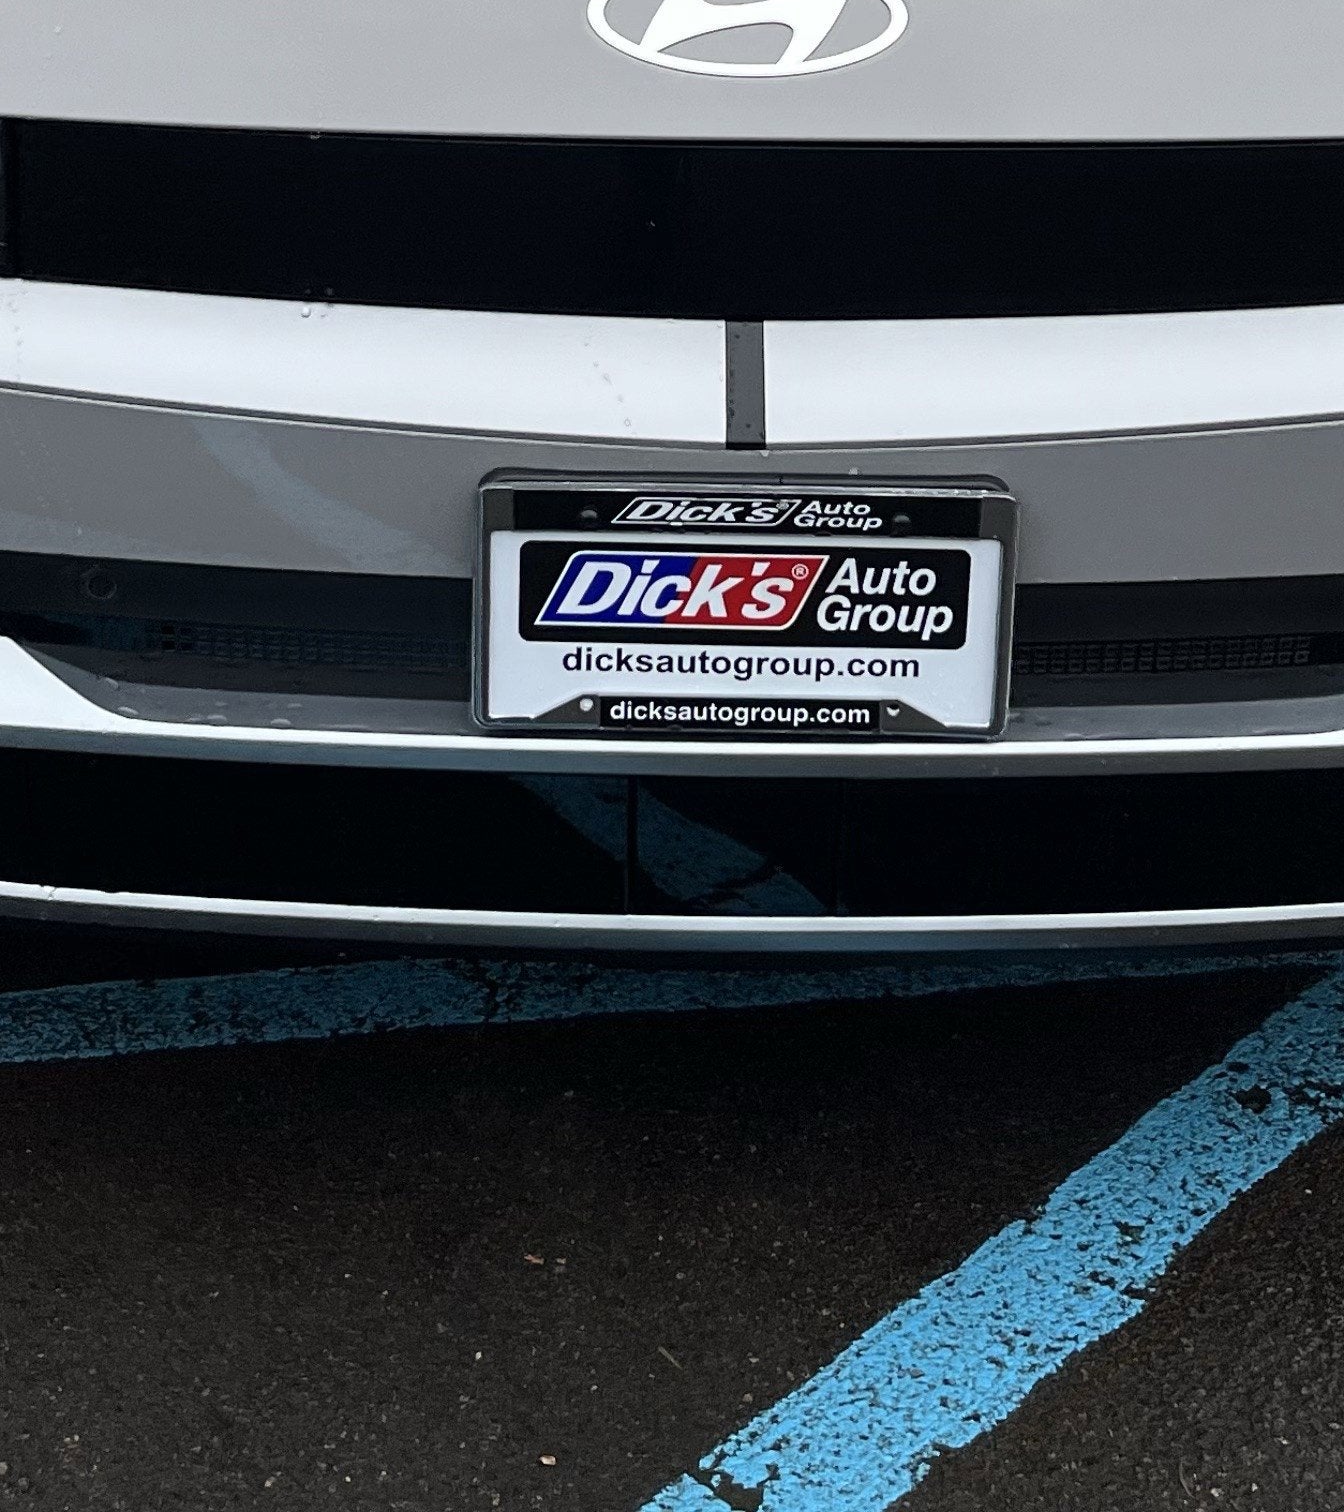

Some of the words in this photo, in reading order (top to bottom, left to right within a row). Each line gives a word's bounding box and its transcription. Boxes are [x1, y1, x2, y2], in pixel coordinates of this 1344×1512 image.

[625, 500, 779, 522] Dick's
[793, 514, 883, 531] Group
[801, 500, 871, 515] Auto
[556, 559, 795, 619] Dick's
[825, 557, 937, 596] Auto
[816, 594, 954, 641] Group
[562, 647, 919, 682] dicksautogroup.com
[609, 700, 871, 727] dicksautogroup.com
